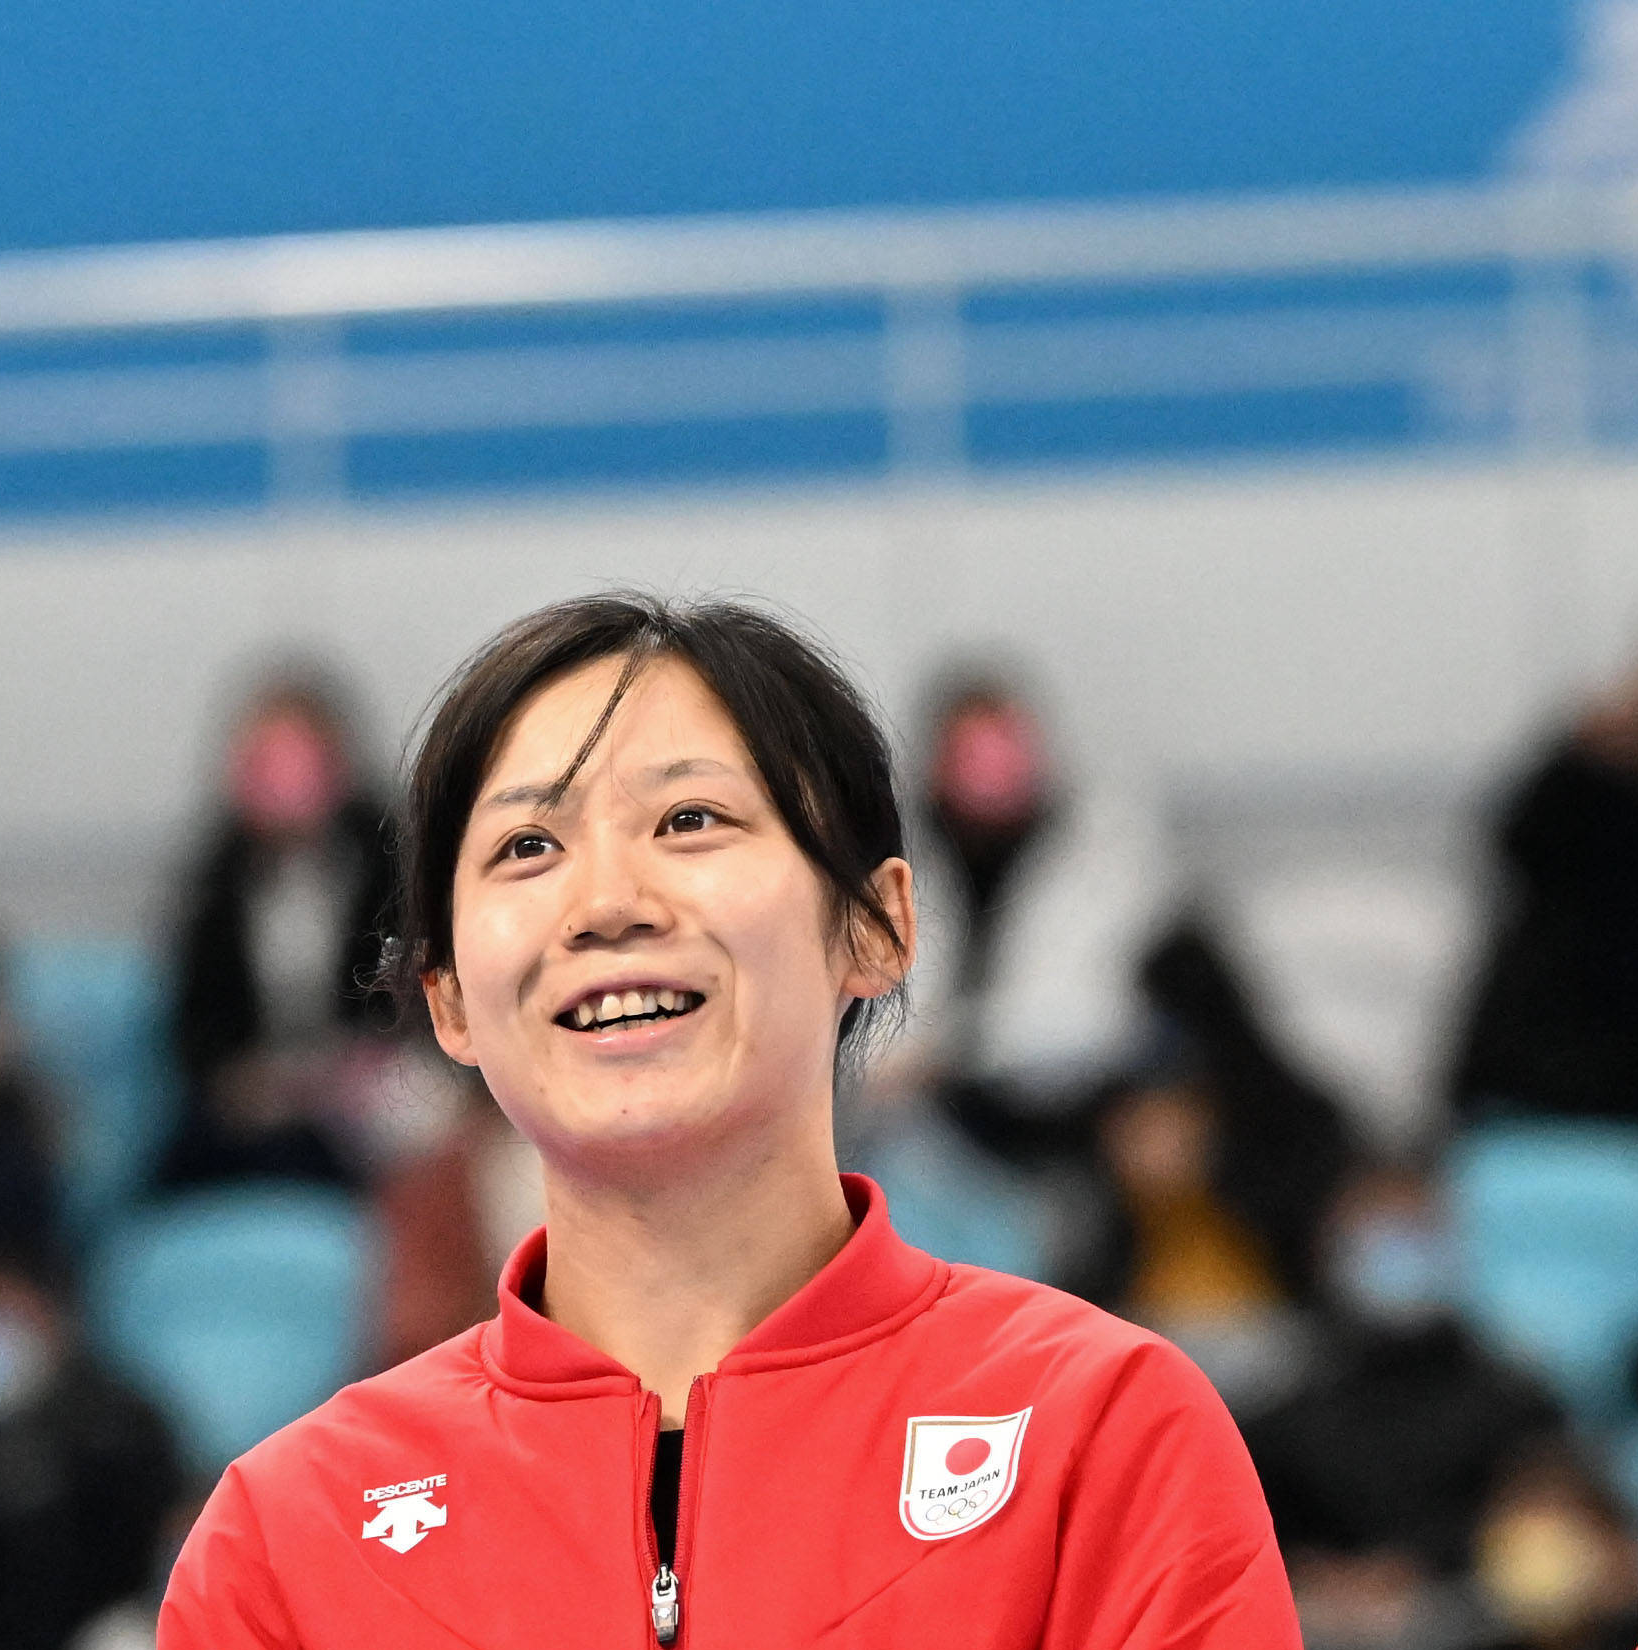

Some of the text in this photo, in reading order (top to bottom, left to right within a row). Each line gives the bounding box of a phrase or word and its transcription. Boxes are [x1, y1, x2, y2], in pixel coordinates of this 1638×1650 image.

[363, 1474, 447, 1502] DESCENTE
[919, 1469, 1001, 1500] TEAM JAPAN
